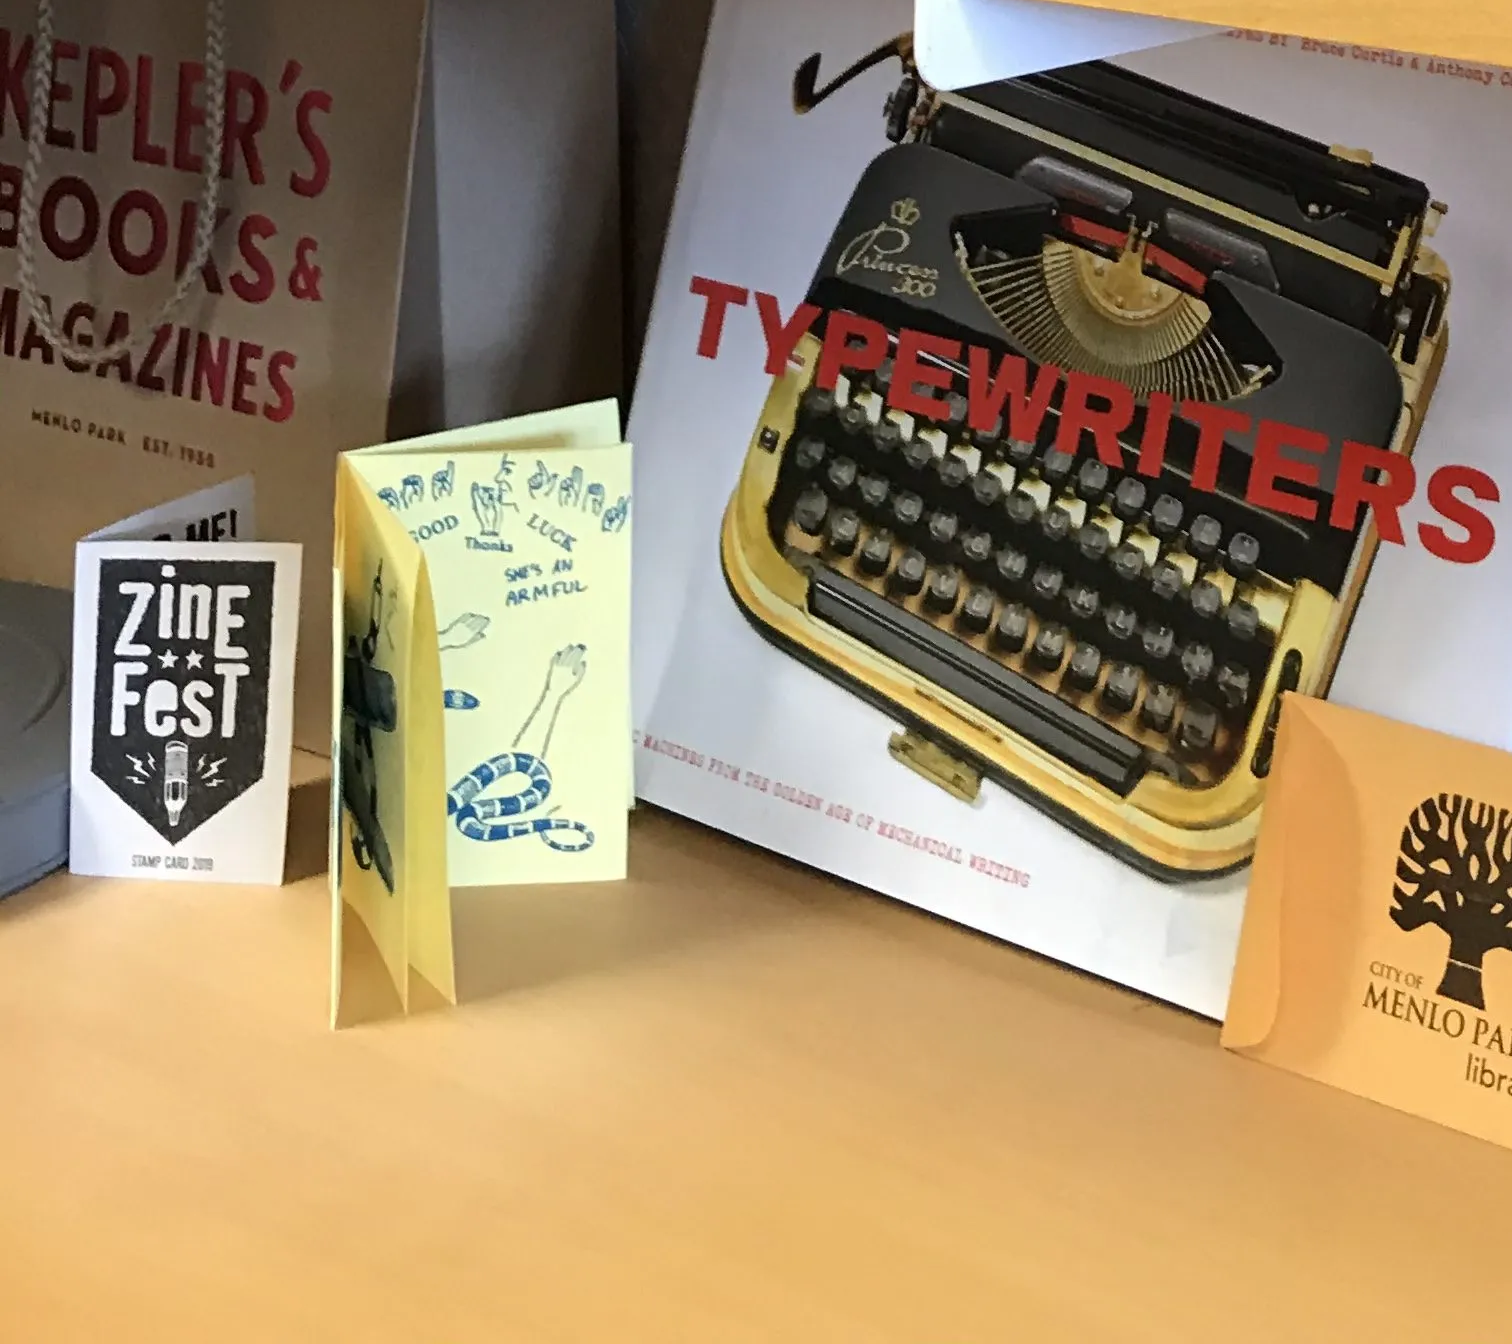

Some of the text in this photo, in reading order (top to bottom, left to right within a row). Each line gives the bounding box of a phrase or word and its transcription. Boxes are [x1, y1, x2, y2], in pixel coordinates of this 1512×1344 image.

[1300, 36, 1346, 58] Bruce
[1350, 44, 1404, 68] Curtis
[1425, 58, 1494, 86] Anthony
[0, 25, 333, 199] KEPLER'S
[0, 162, 324, 305] BOOKS &
[31, 408, 82, 434] MENLO
[87, 422, 127, 446] PARK
[688, 276, 1502, 565] TYPEWRITERS
[464, 535, 514, 554] Thanks
[526, 512, 578, 553] LUCK
[551, 559, 574, 575] AN
[504, 579, 589, 607] ARMFUL
[131, 854, 190, 870] STAMP CARD
[1369, 960, 1425, 990] CITY OF
[1362, 981, 1466, 1038] MENLO
